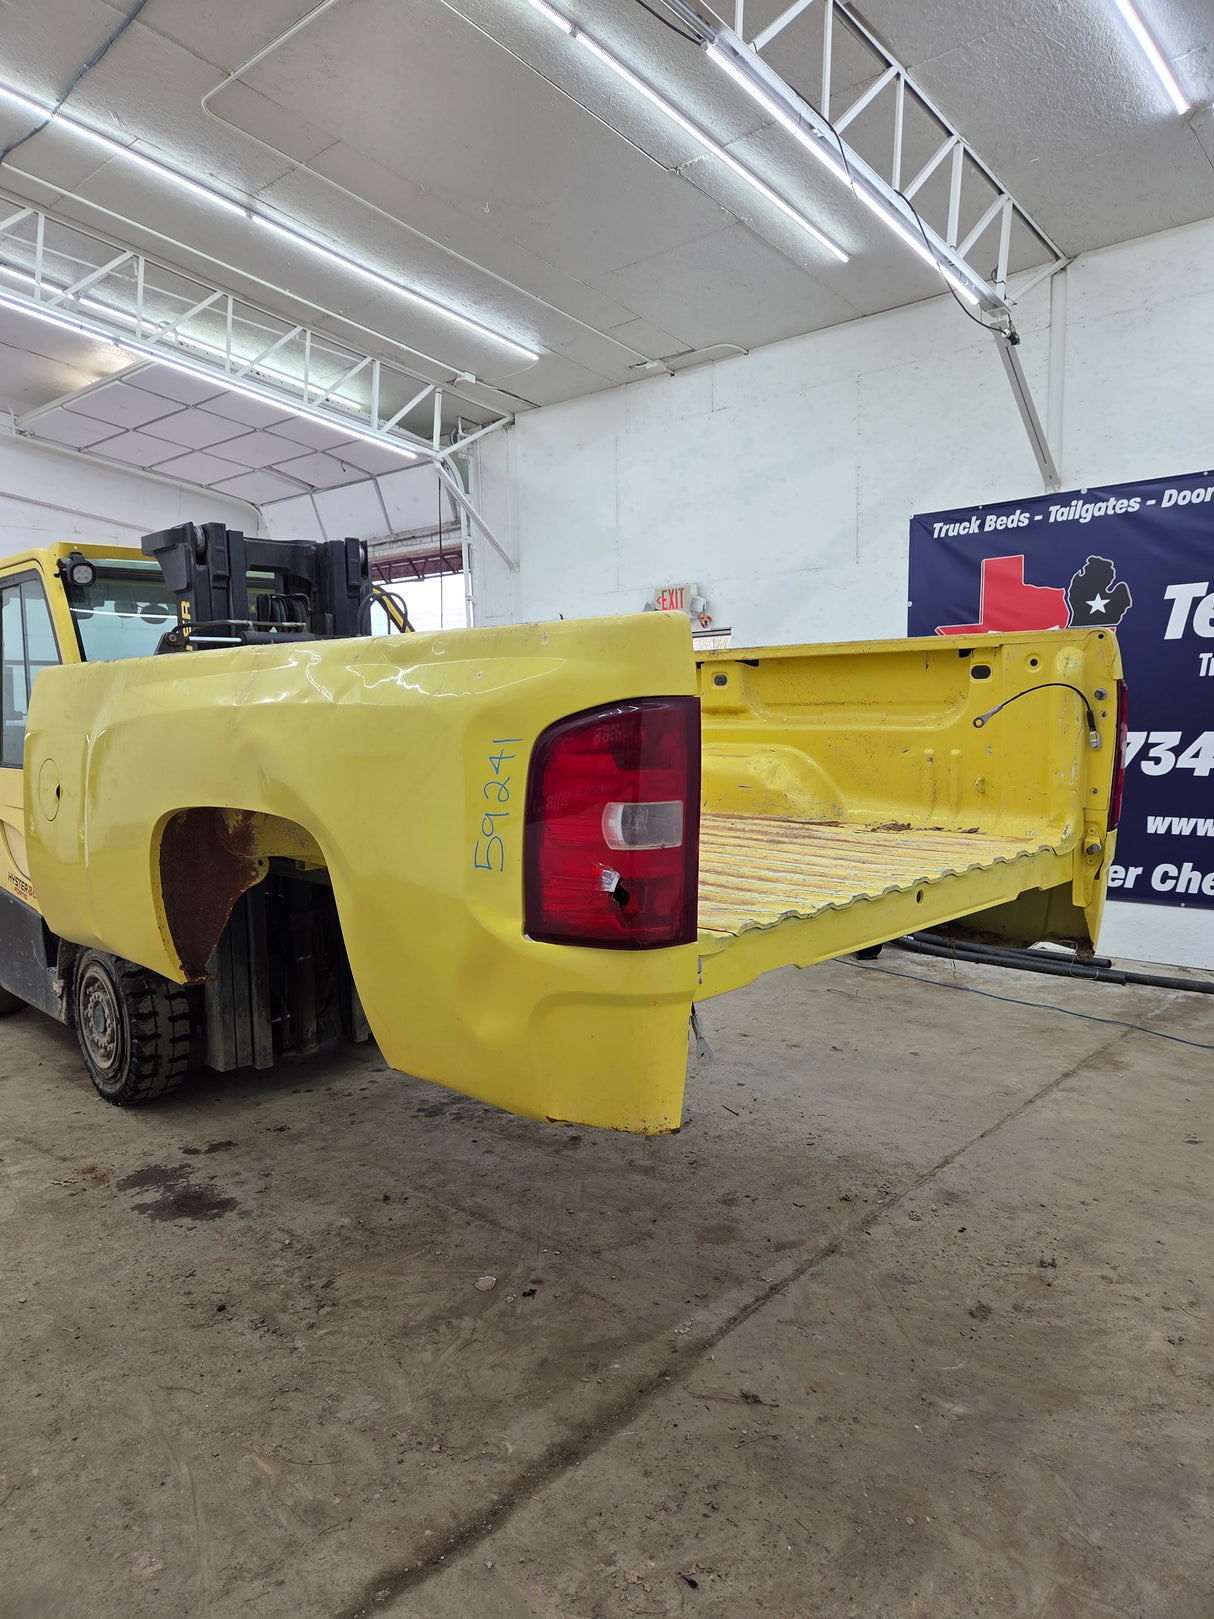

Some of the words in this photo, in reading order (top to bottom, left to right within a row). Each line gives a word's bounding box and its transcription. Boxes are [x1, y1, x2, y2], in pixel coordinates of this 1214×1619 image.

[932, 516, 981, 538] Truck
[983, 509, 1030, 532] Beds
[1048, 496, 1142, 524] Tailgates
[661, 587, 685, 611] EXIT
[474, 738, 523, 872] 59241
